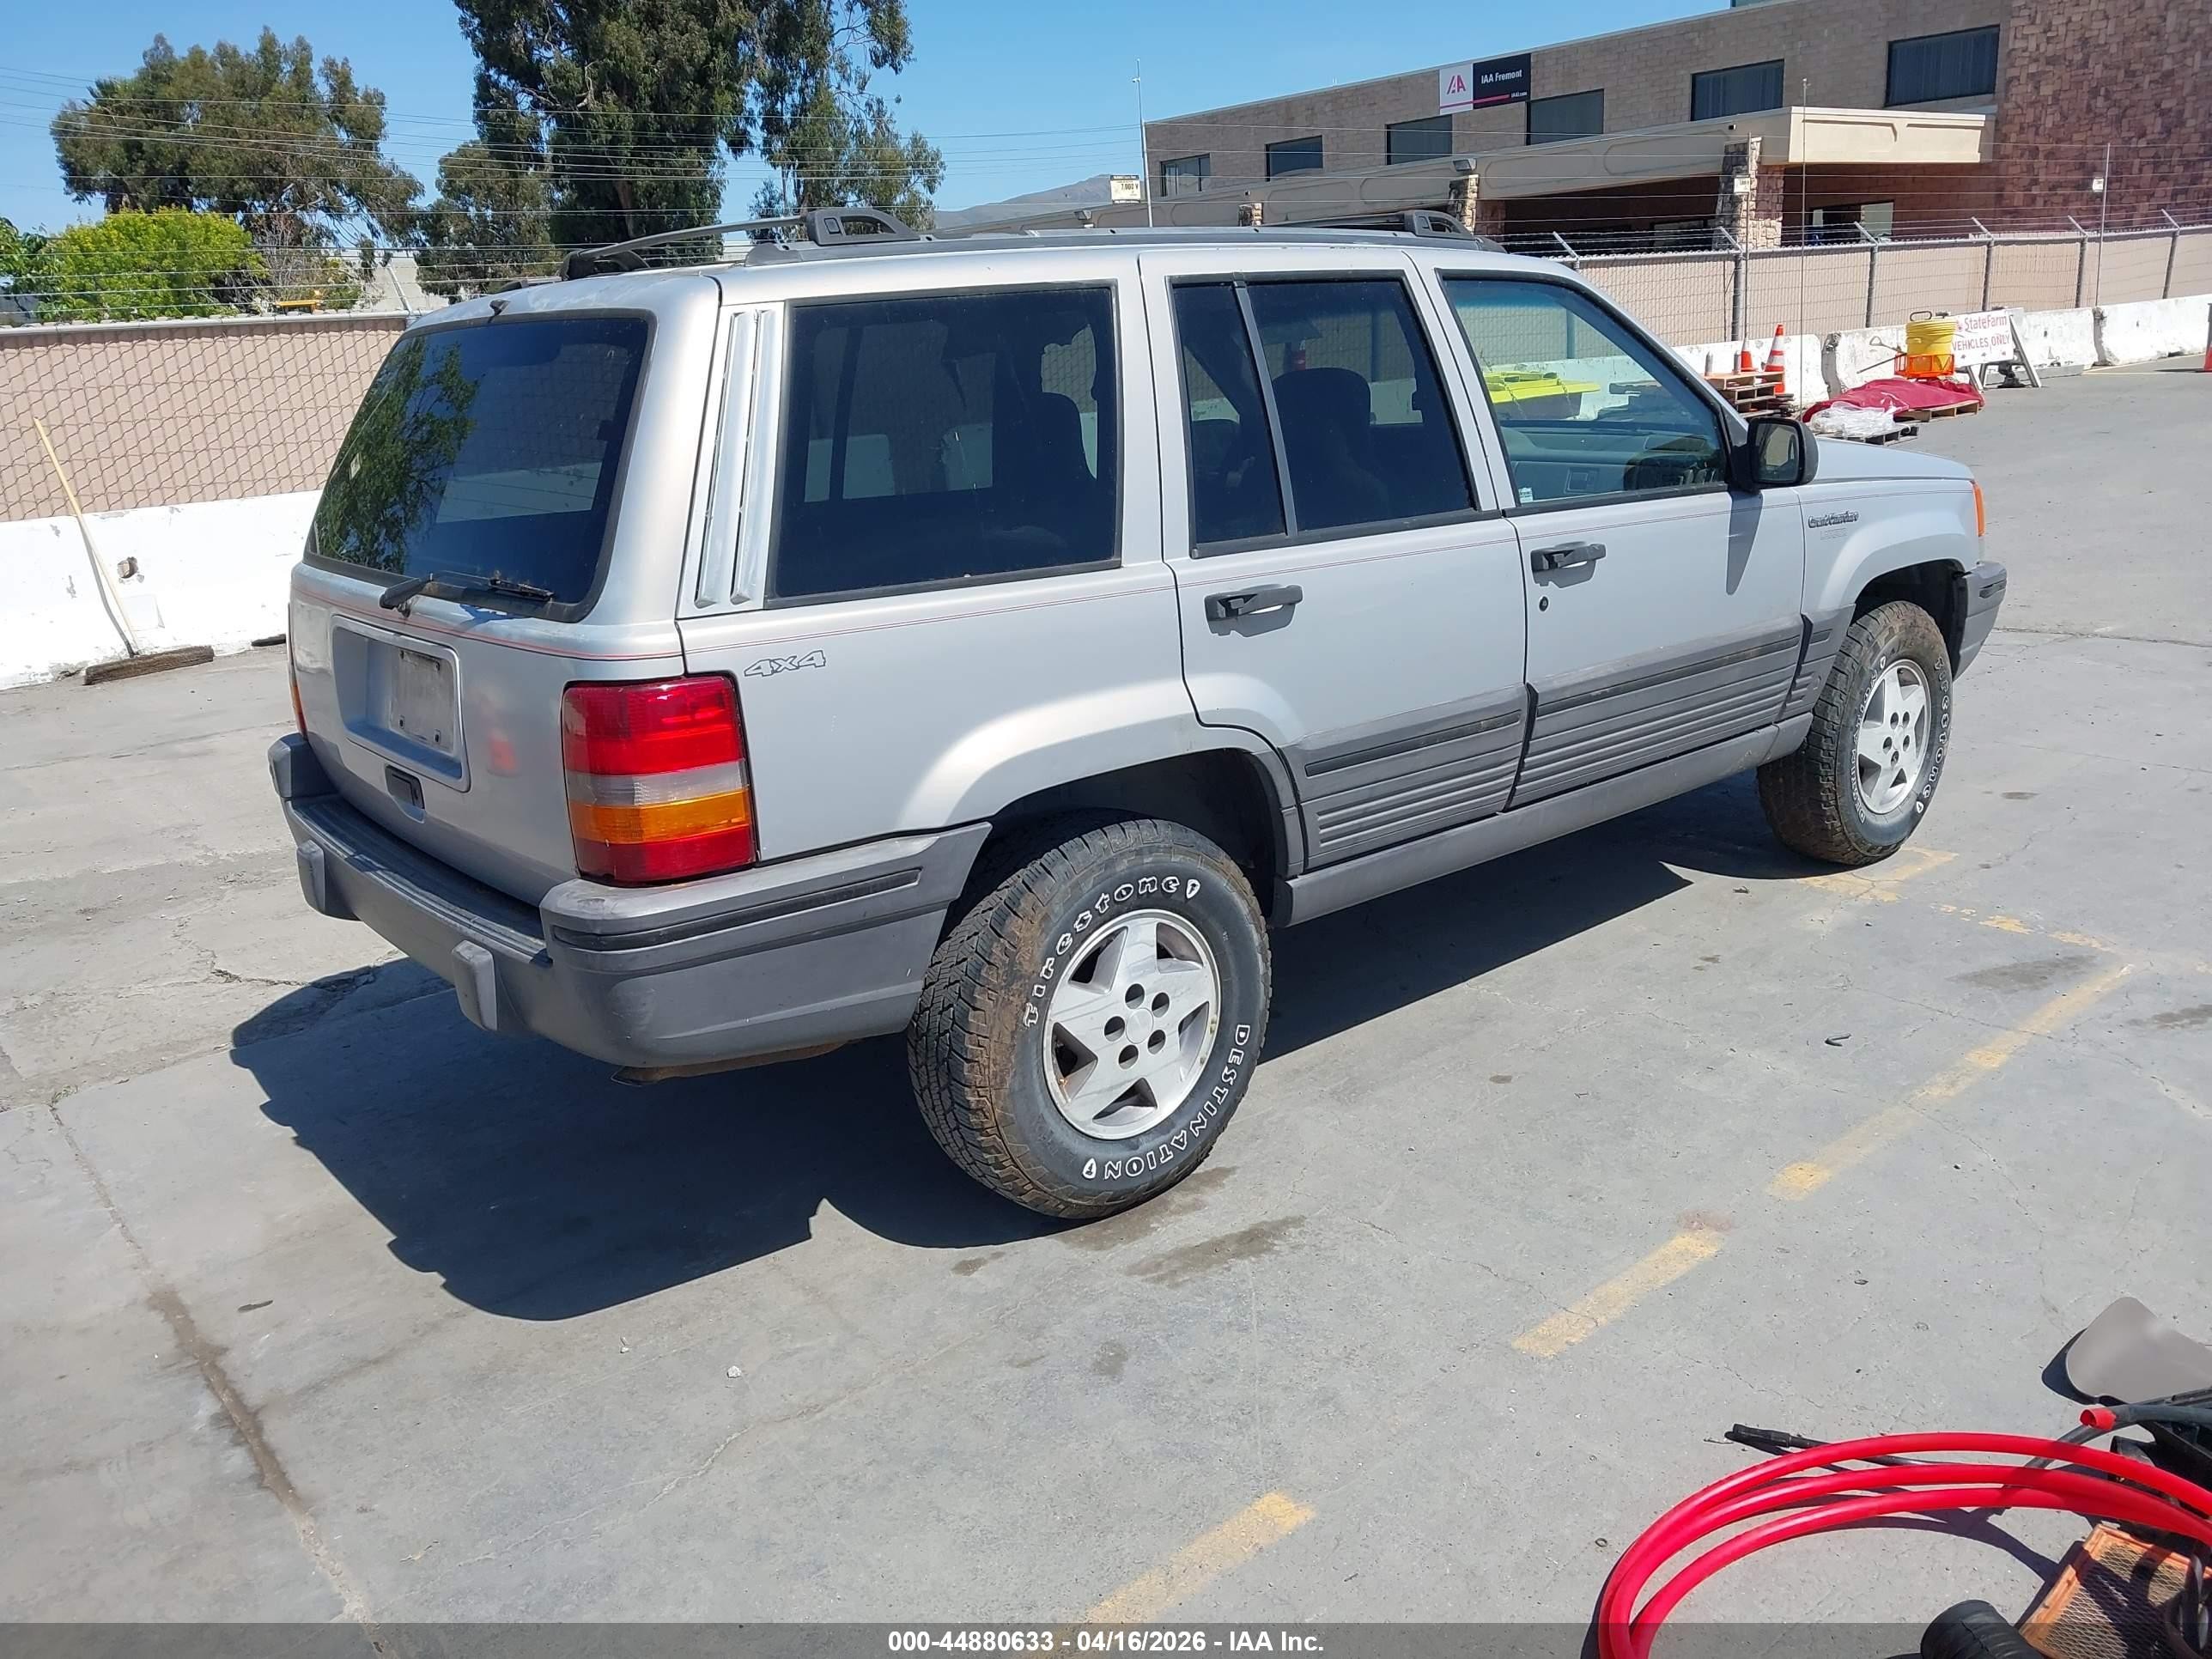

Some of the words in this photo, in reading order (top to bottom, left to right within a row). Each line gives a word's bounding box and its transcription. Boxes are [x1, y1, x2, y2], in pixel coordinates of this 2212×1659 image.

[1481, 75, 1494, 84] IAA
[1495, 70, 1522, 82] Fremont
[1952, 337, 1989, 351] VEHICLES
[1991, 334, 2010, 346] ONLY
[1024, 876, 1180, 1028] Firestone
[1103, 1024, 1250, 1180] DESTINATION
